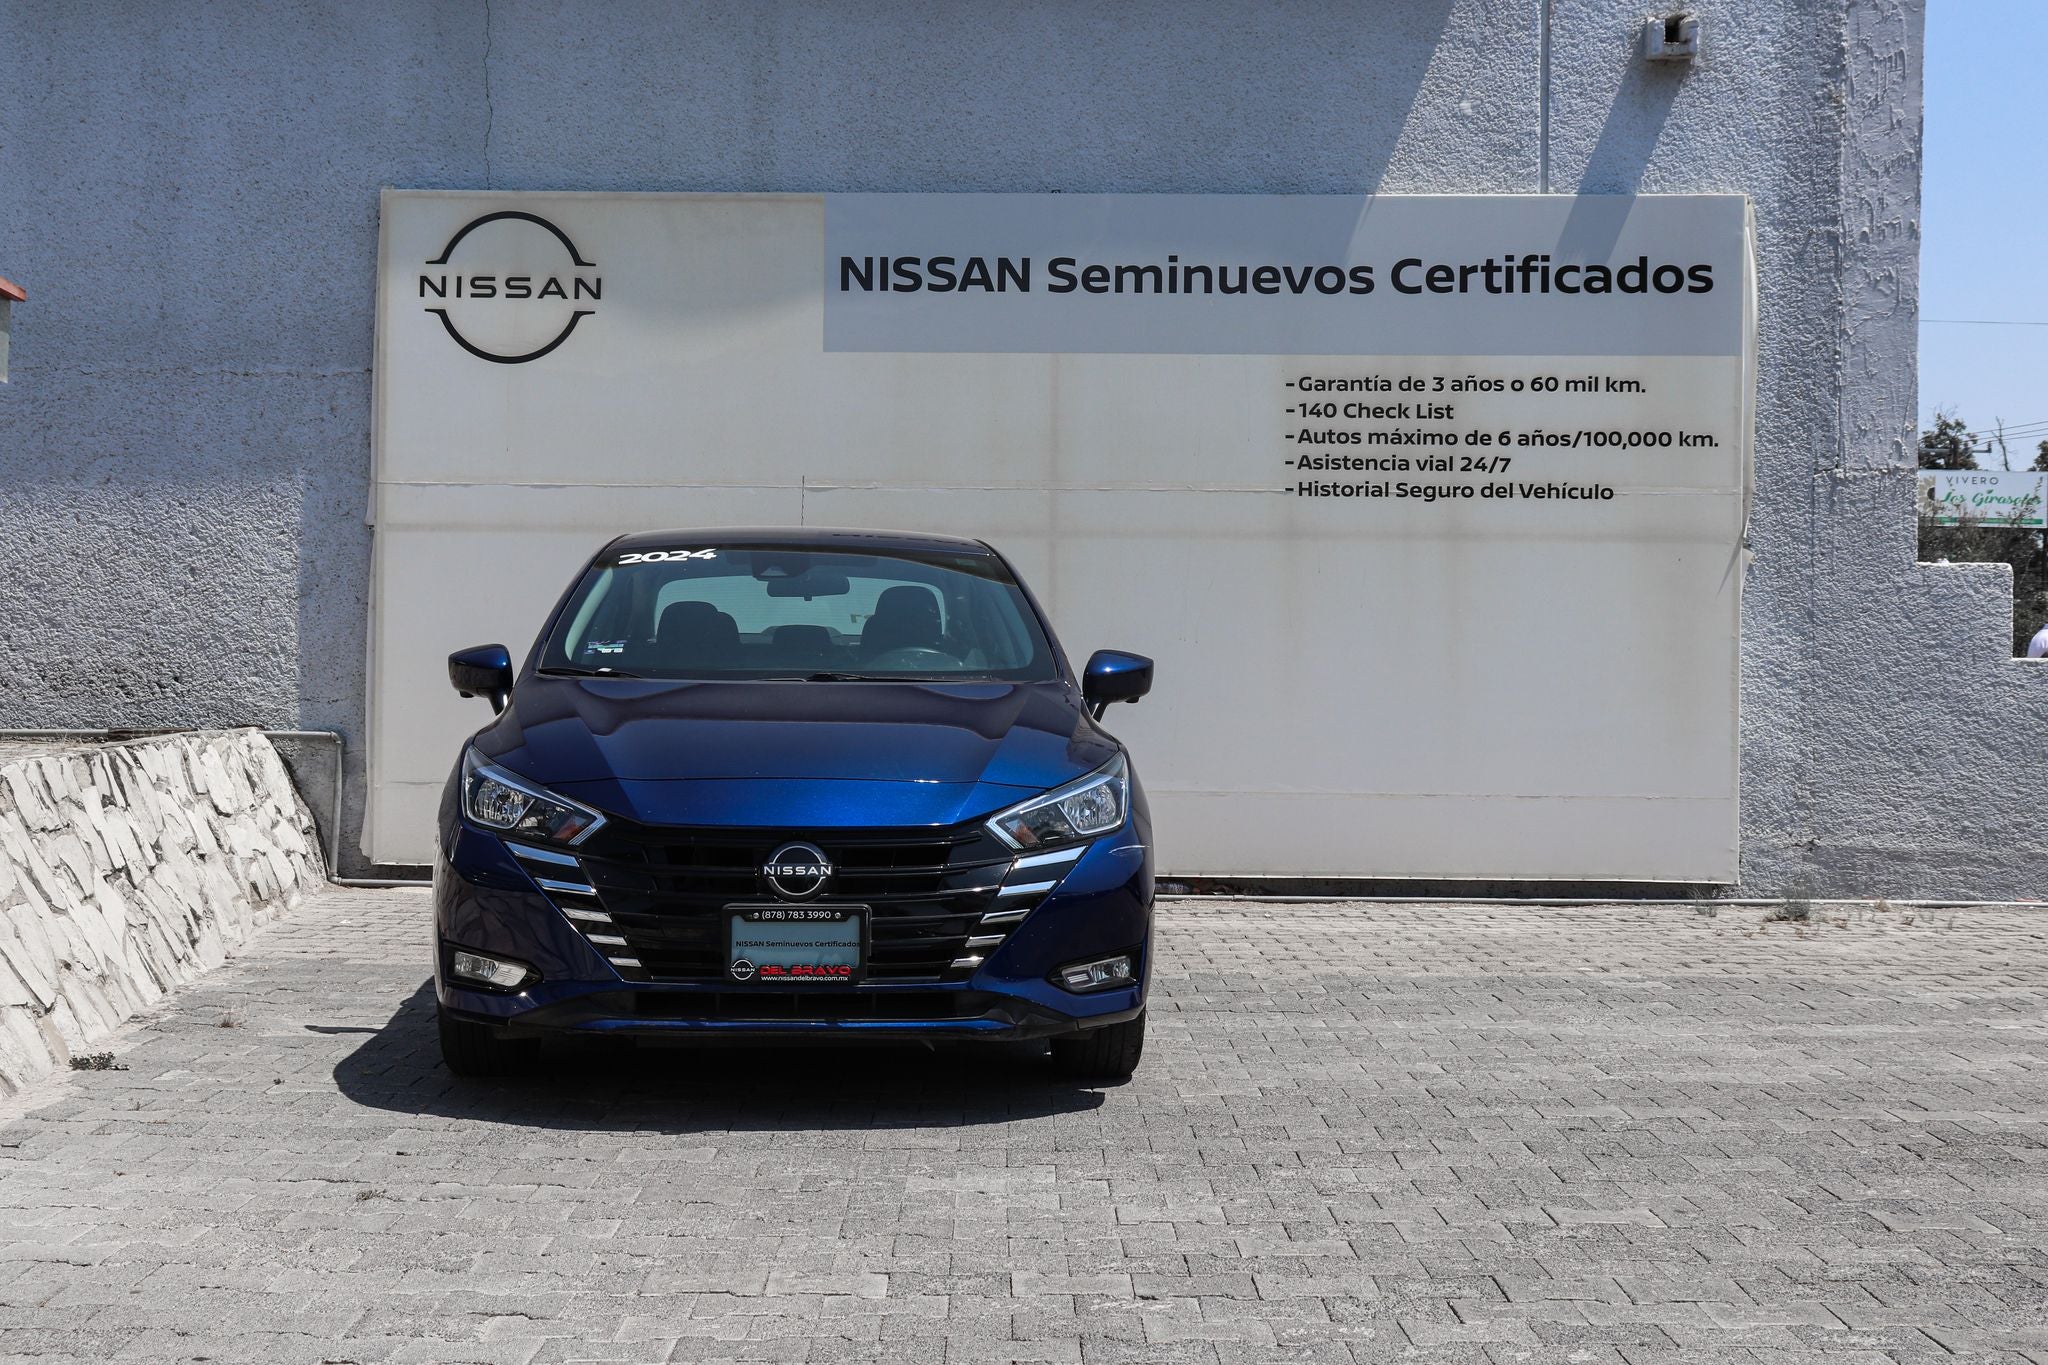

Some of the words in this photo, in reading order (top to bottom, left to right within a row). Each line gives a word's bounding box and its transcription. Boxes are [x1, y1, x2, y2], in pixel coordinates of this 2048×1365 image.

[840, 256, 1031, 293] NISSAN
[1047, 255, 1375, 295] Seminuevos
[1390, 254, 1714, 295] Certificados
[419, 274, 602, 300] NISSAN
[1398, 375, 1426, 392] de
[1432, 376, 1445, 392] 3
[1450, 375, 1505, 392] años
[1510, 379, 1525, 392] o
[1530, 376, 1559, 392] 60
[1565, 375, 1599, 393] mil
[1605, 376, 1646, 393] km.
[1343, 402, 1411, 419] Check
[1416, 402, 1454, 420] List
[1368, 427, 1459, 446] máximo
[1464, 429, 1492, 446] de
[1498, 430, 1512, 447] 6
[1517, 429, 1673, 450] años/100,000
[1679, 430, 1719, 448] km.
[1415, 454, 1454, 472] vial
[1460, 456, 1512, 474] 24/7
[1946, 476, 1999, 485] VIVERO
[1395, 482, 1475, 503] Seguro
[1480, 482, 1514, 499] del
[1518, 482, 1615, 500] Vehículo
[618, 548, 718, 565] 2024
[763, 866, 832, 876] NISSAN
[761, 910, 786, 920] (878)
[788, 910, 805, 919] 783
[807, 910, 831, 919] 3990
[735, 940, 765, 948] NISSAN
[766, 940, 813, 948] Seminuevos
[759, 965, 788, 976] DEL
[790, 965, 852, 976] BRAVO
